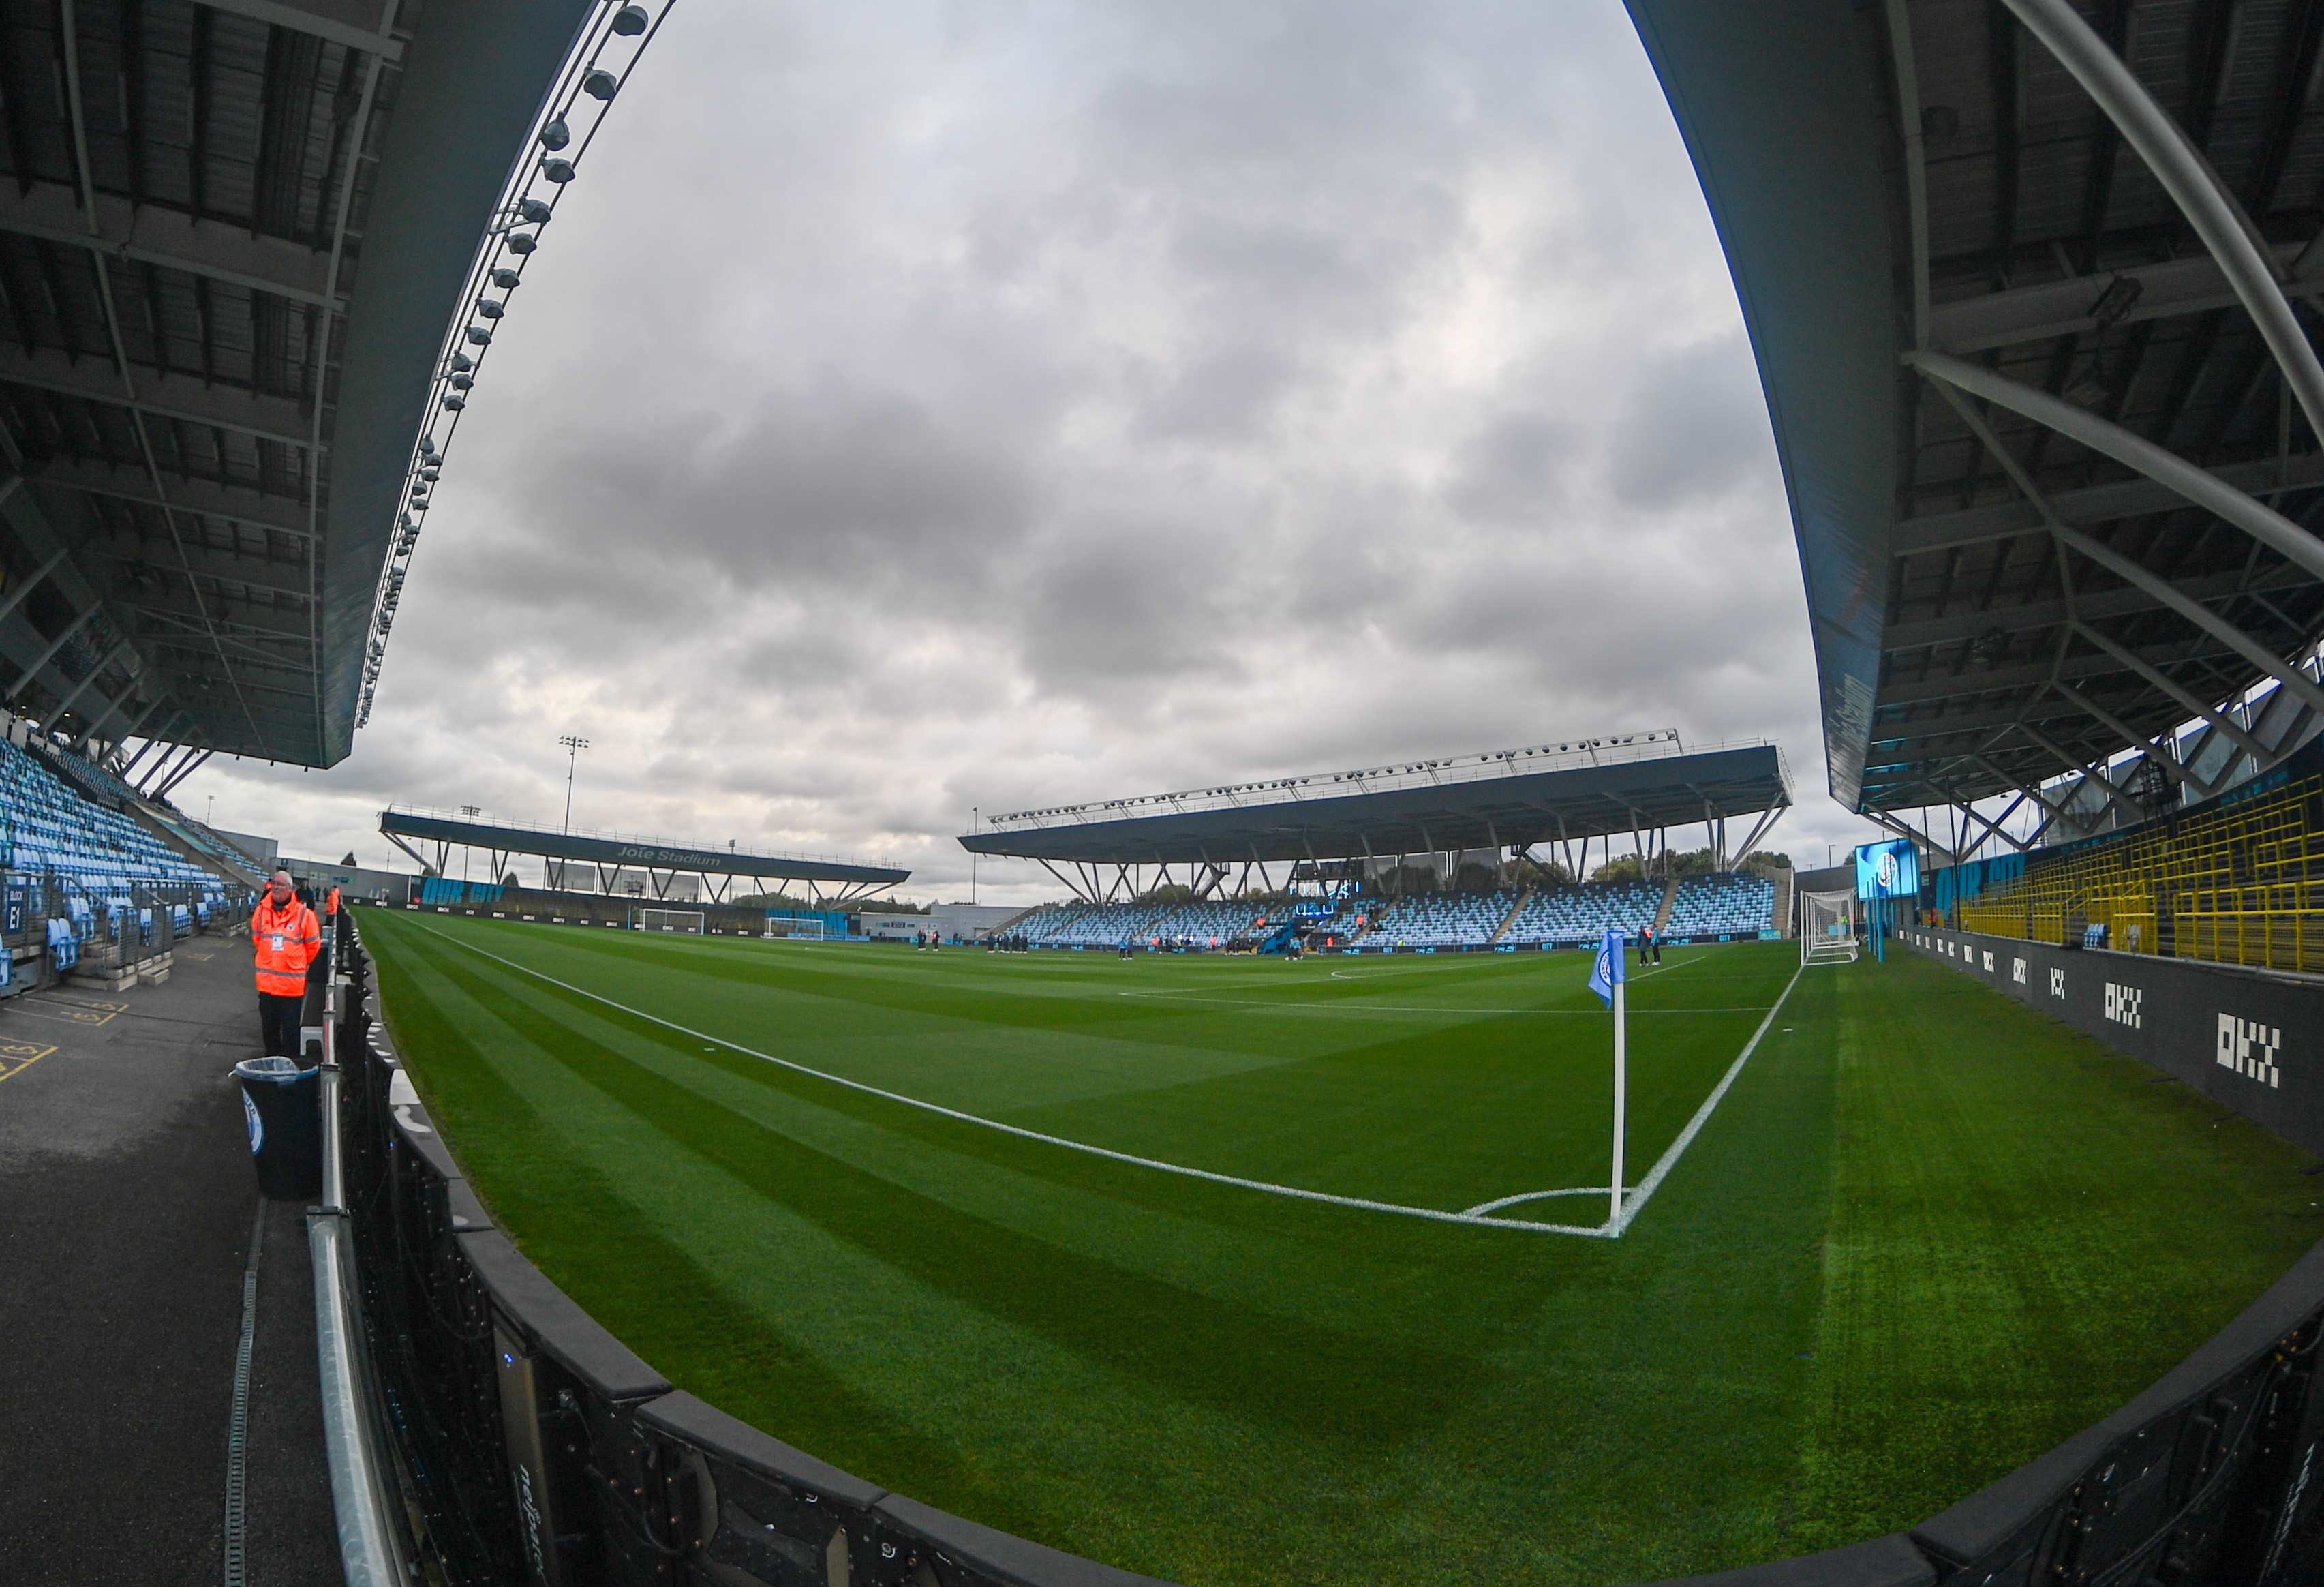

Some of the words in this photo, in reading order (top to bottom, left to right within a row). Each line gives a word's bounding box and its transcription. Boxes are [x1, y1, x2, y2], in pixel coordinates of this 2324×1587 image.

[657, 851, 720, 866] Stadium
[422, 877, 465, 905] OUR
[469, 884, 504, 903] CITY
[1936, 862, 1981, 919] OUR
[10, 906, 20, 929] E1
[2013, 957, 2026, 985] OKX
[2105, 982, 2142, 1029] OKX
[2216, 1012, 2280, 1089] OKX
